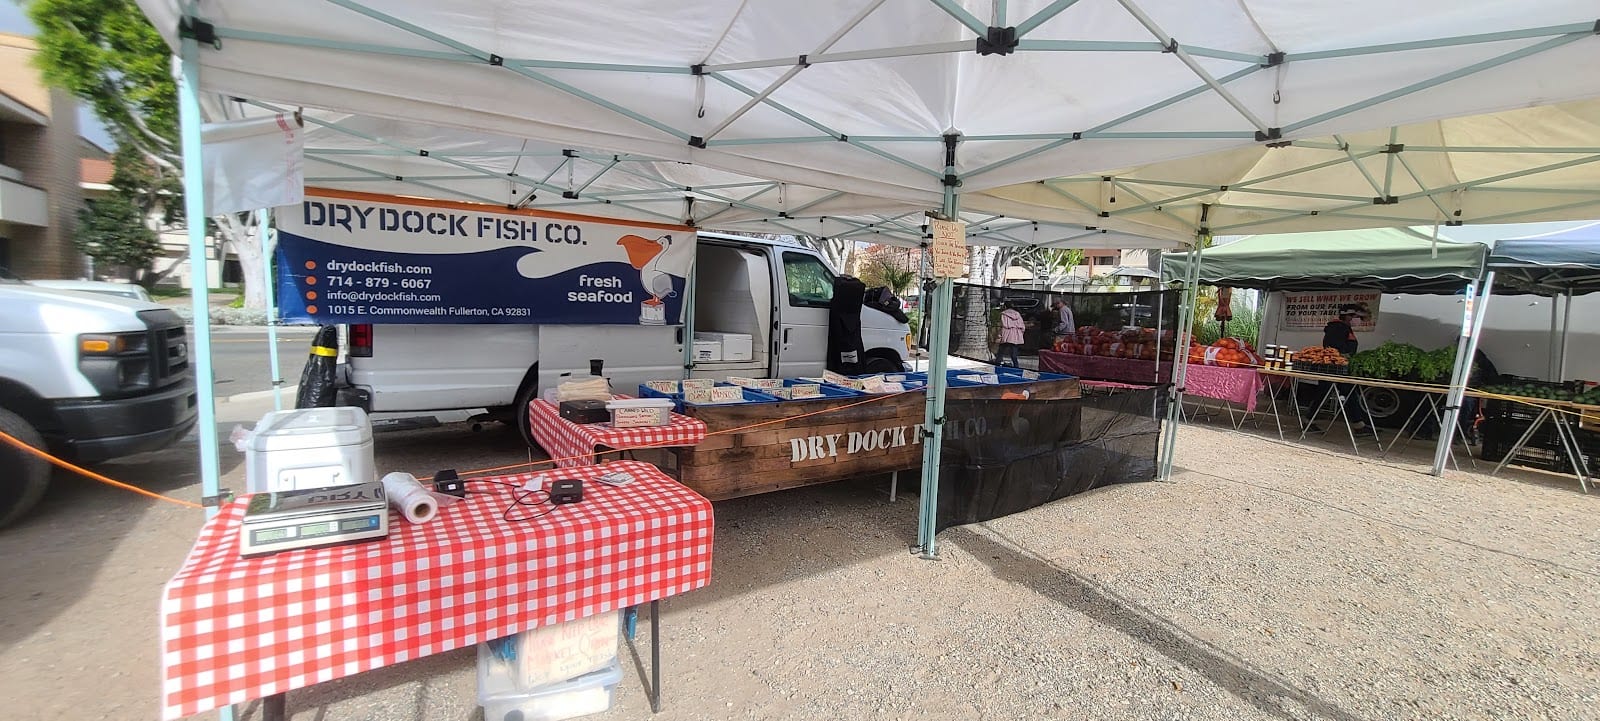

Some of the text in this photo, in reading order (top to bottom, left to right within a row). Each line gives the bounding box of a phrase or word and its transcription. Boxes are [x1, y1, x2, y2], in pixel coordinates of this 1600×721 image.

[303, 200, 588, 246] DRY DOCK FISH CO.
[326, 260, 432, 275] drydockfish.com
[327, 276, 353, 287] 714
[365, 277, 389, 288] 879
[401, 278, 432, 289] 6067
[579, 274, 622, 288] fresh
[327, 290, 441, 302] info@drydockfish.com
[567, 291, 633, 303] seafood
[328, 305, 531, 317] 1015 E. Commonwealth Fullerton, CA 92831
[790, 433, 842, 463] DRY
[847, 425, 908, 455] DOCK
